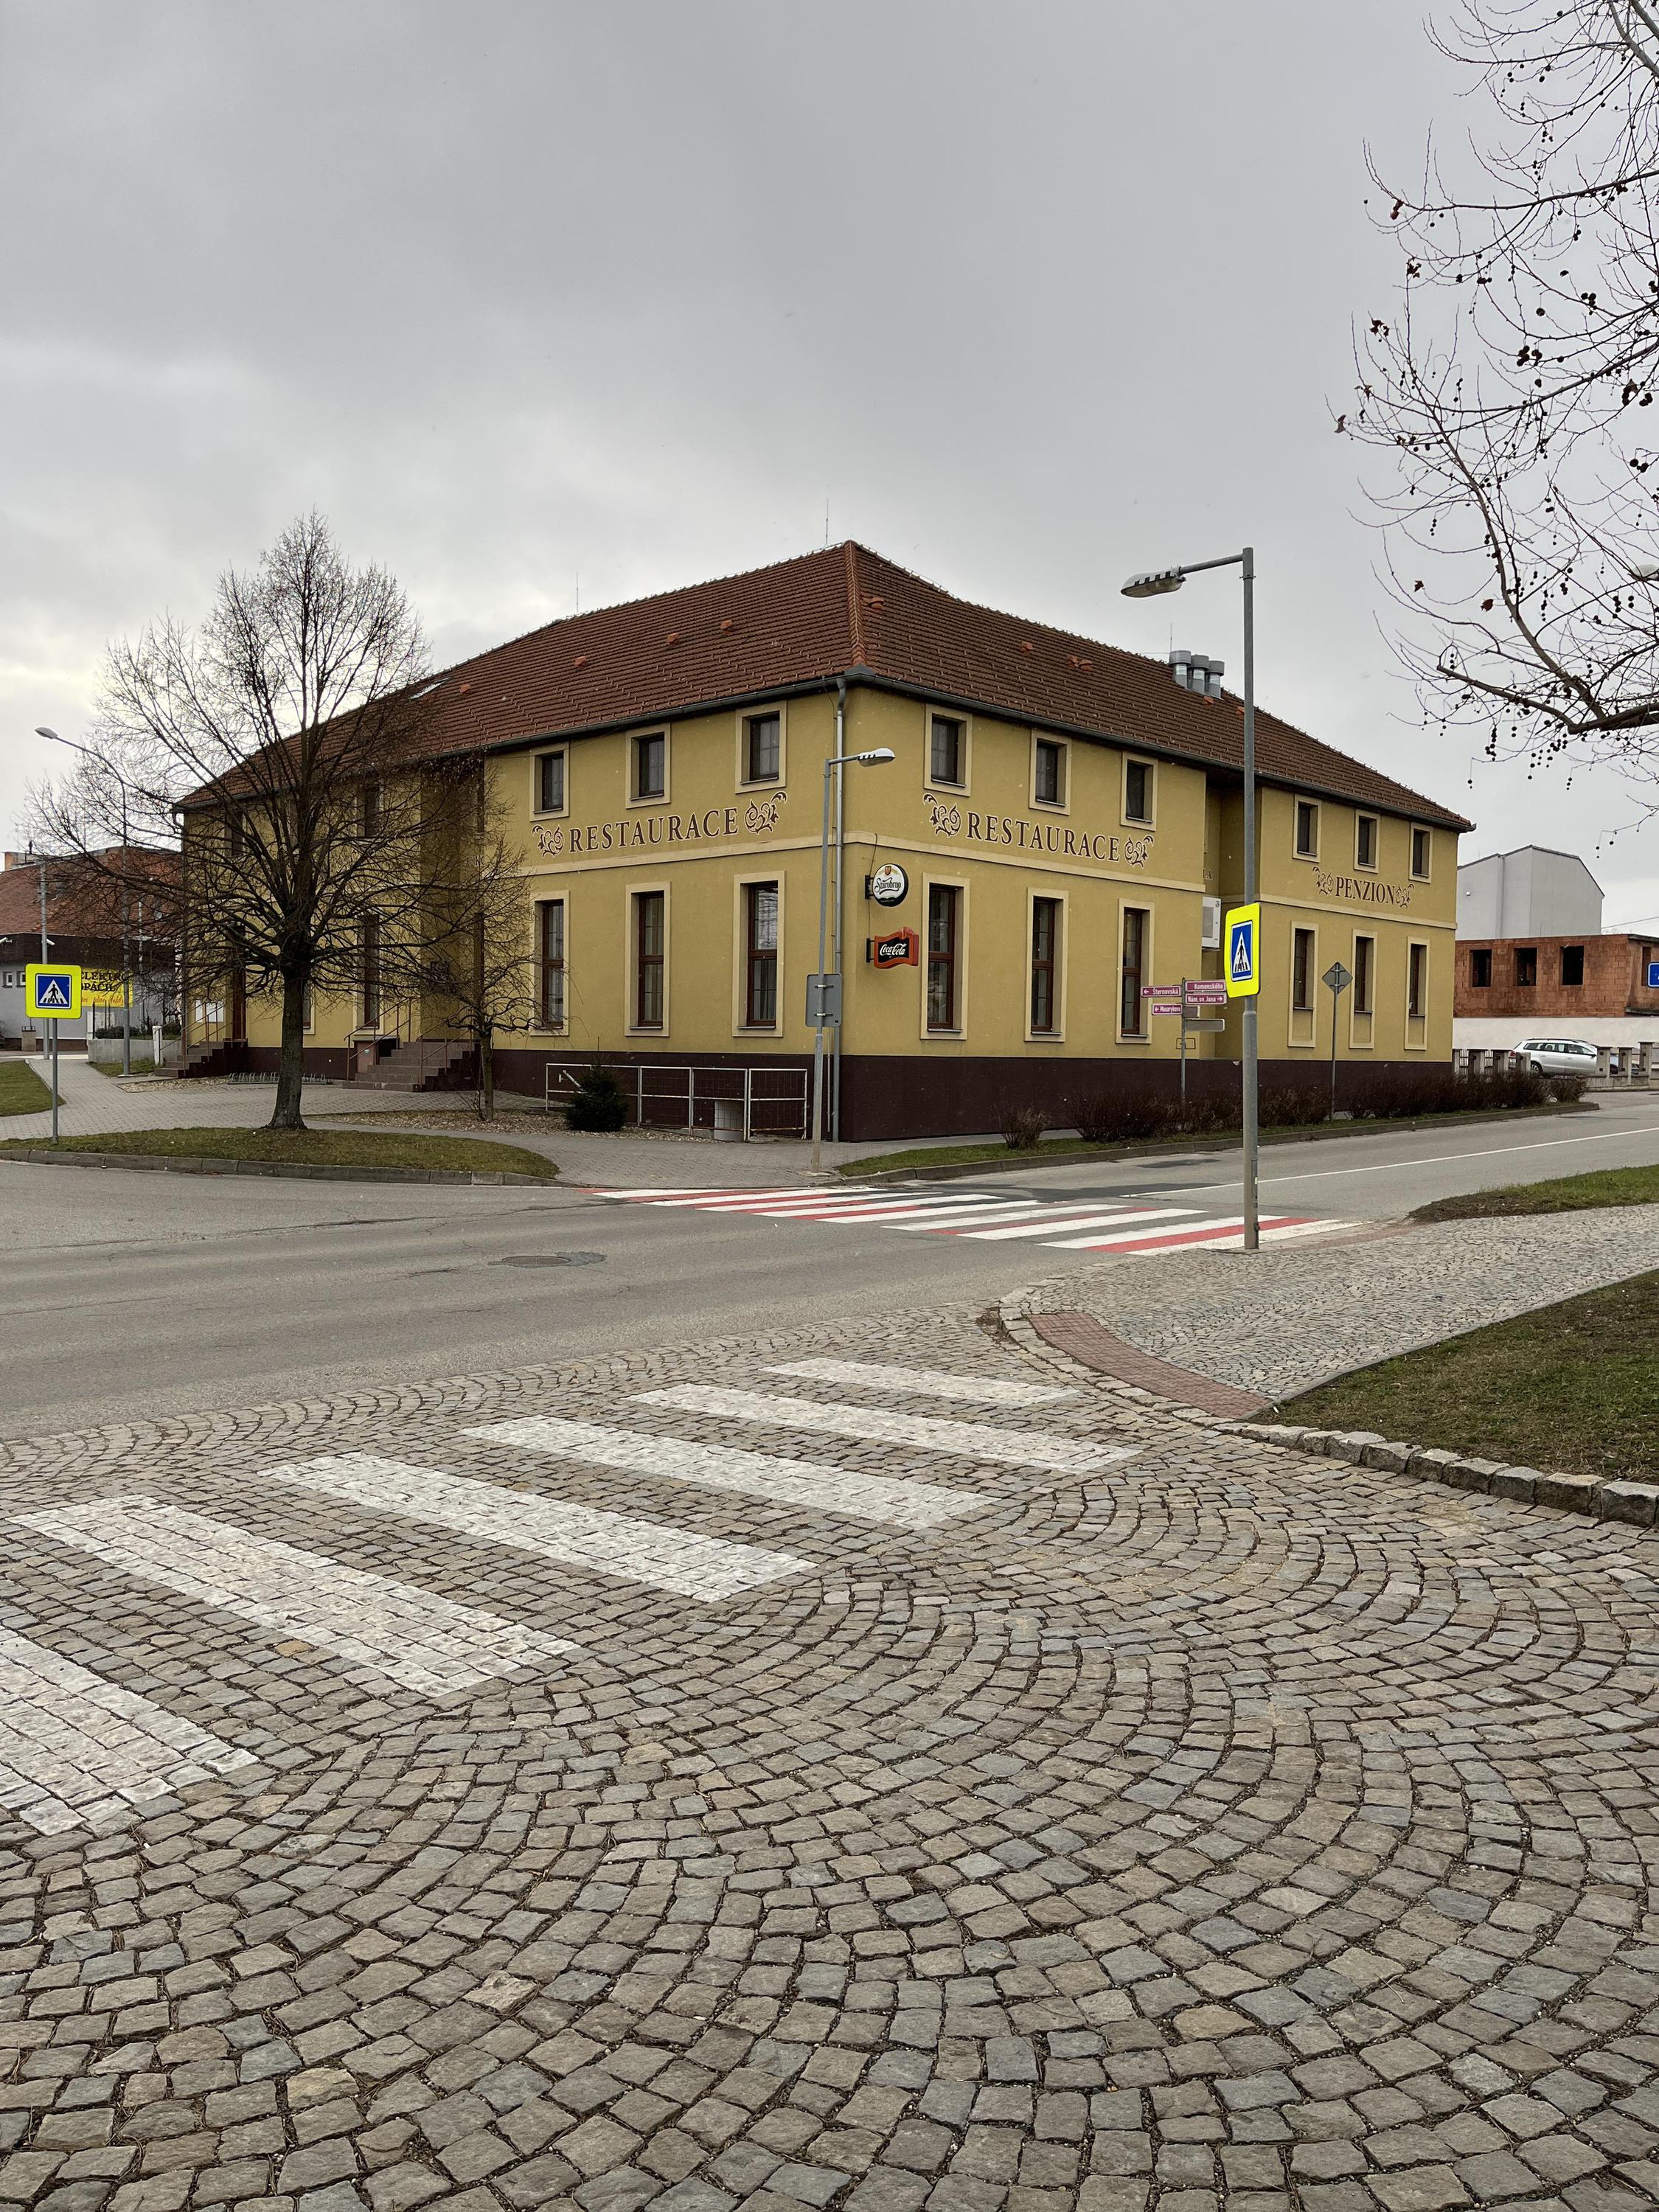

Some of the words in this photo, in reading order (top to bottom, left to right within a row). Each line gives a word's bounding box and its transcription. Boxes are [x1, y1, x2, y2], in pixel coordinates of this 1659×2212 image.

[568, 807, 738, 853] RESTAURACE
[967, 812, 1120, 862] RESTAURACE
[1335, 876, 1395, 905] PENZION
